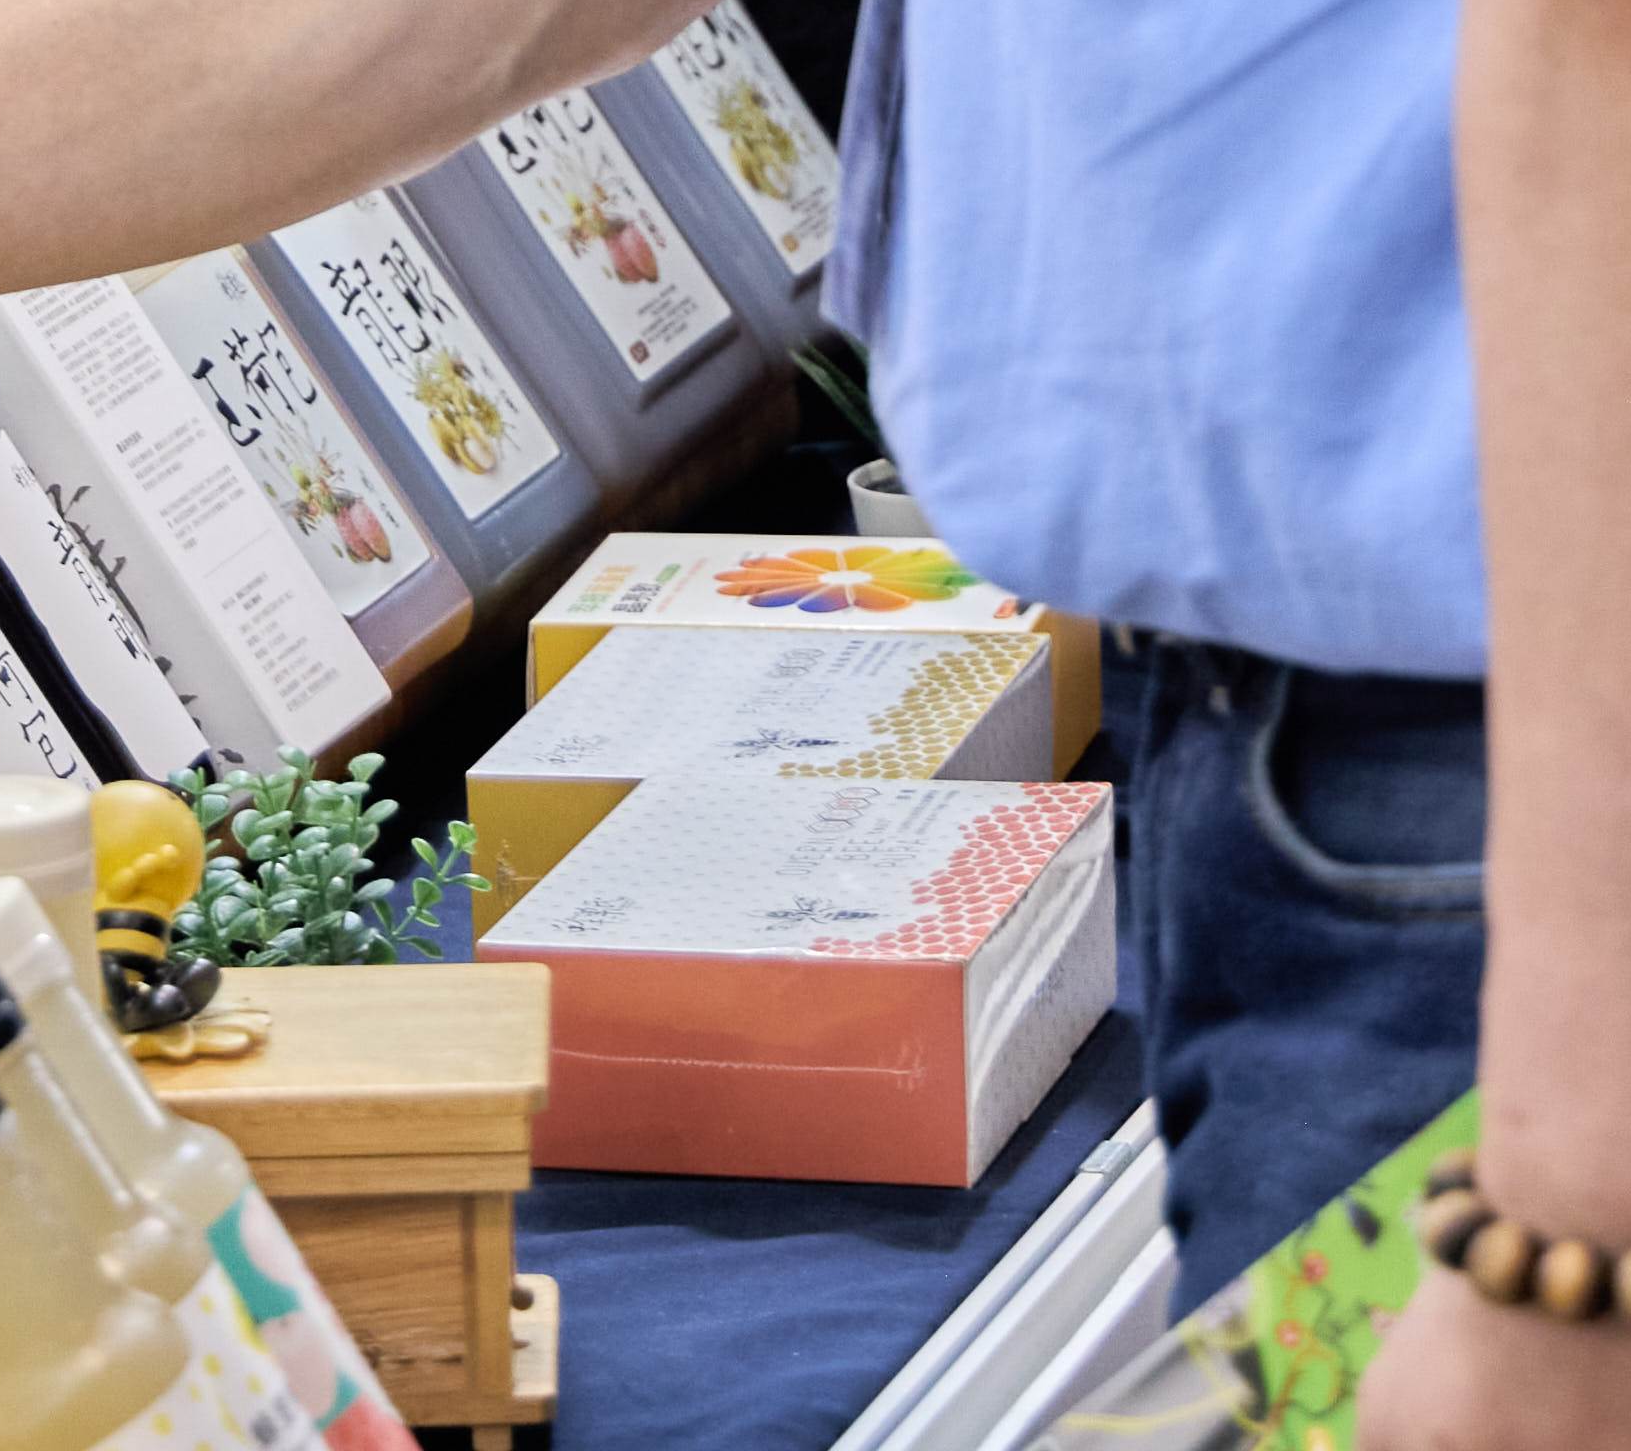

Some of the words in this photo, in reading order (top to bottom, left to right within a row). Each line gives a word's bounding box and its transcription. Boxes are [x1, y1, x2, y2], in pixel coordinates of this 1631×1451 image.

[320, 237, 459, 369] 龍眼
[191, 320, 318, 448] 玉荷包
